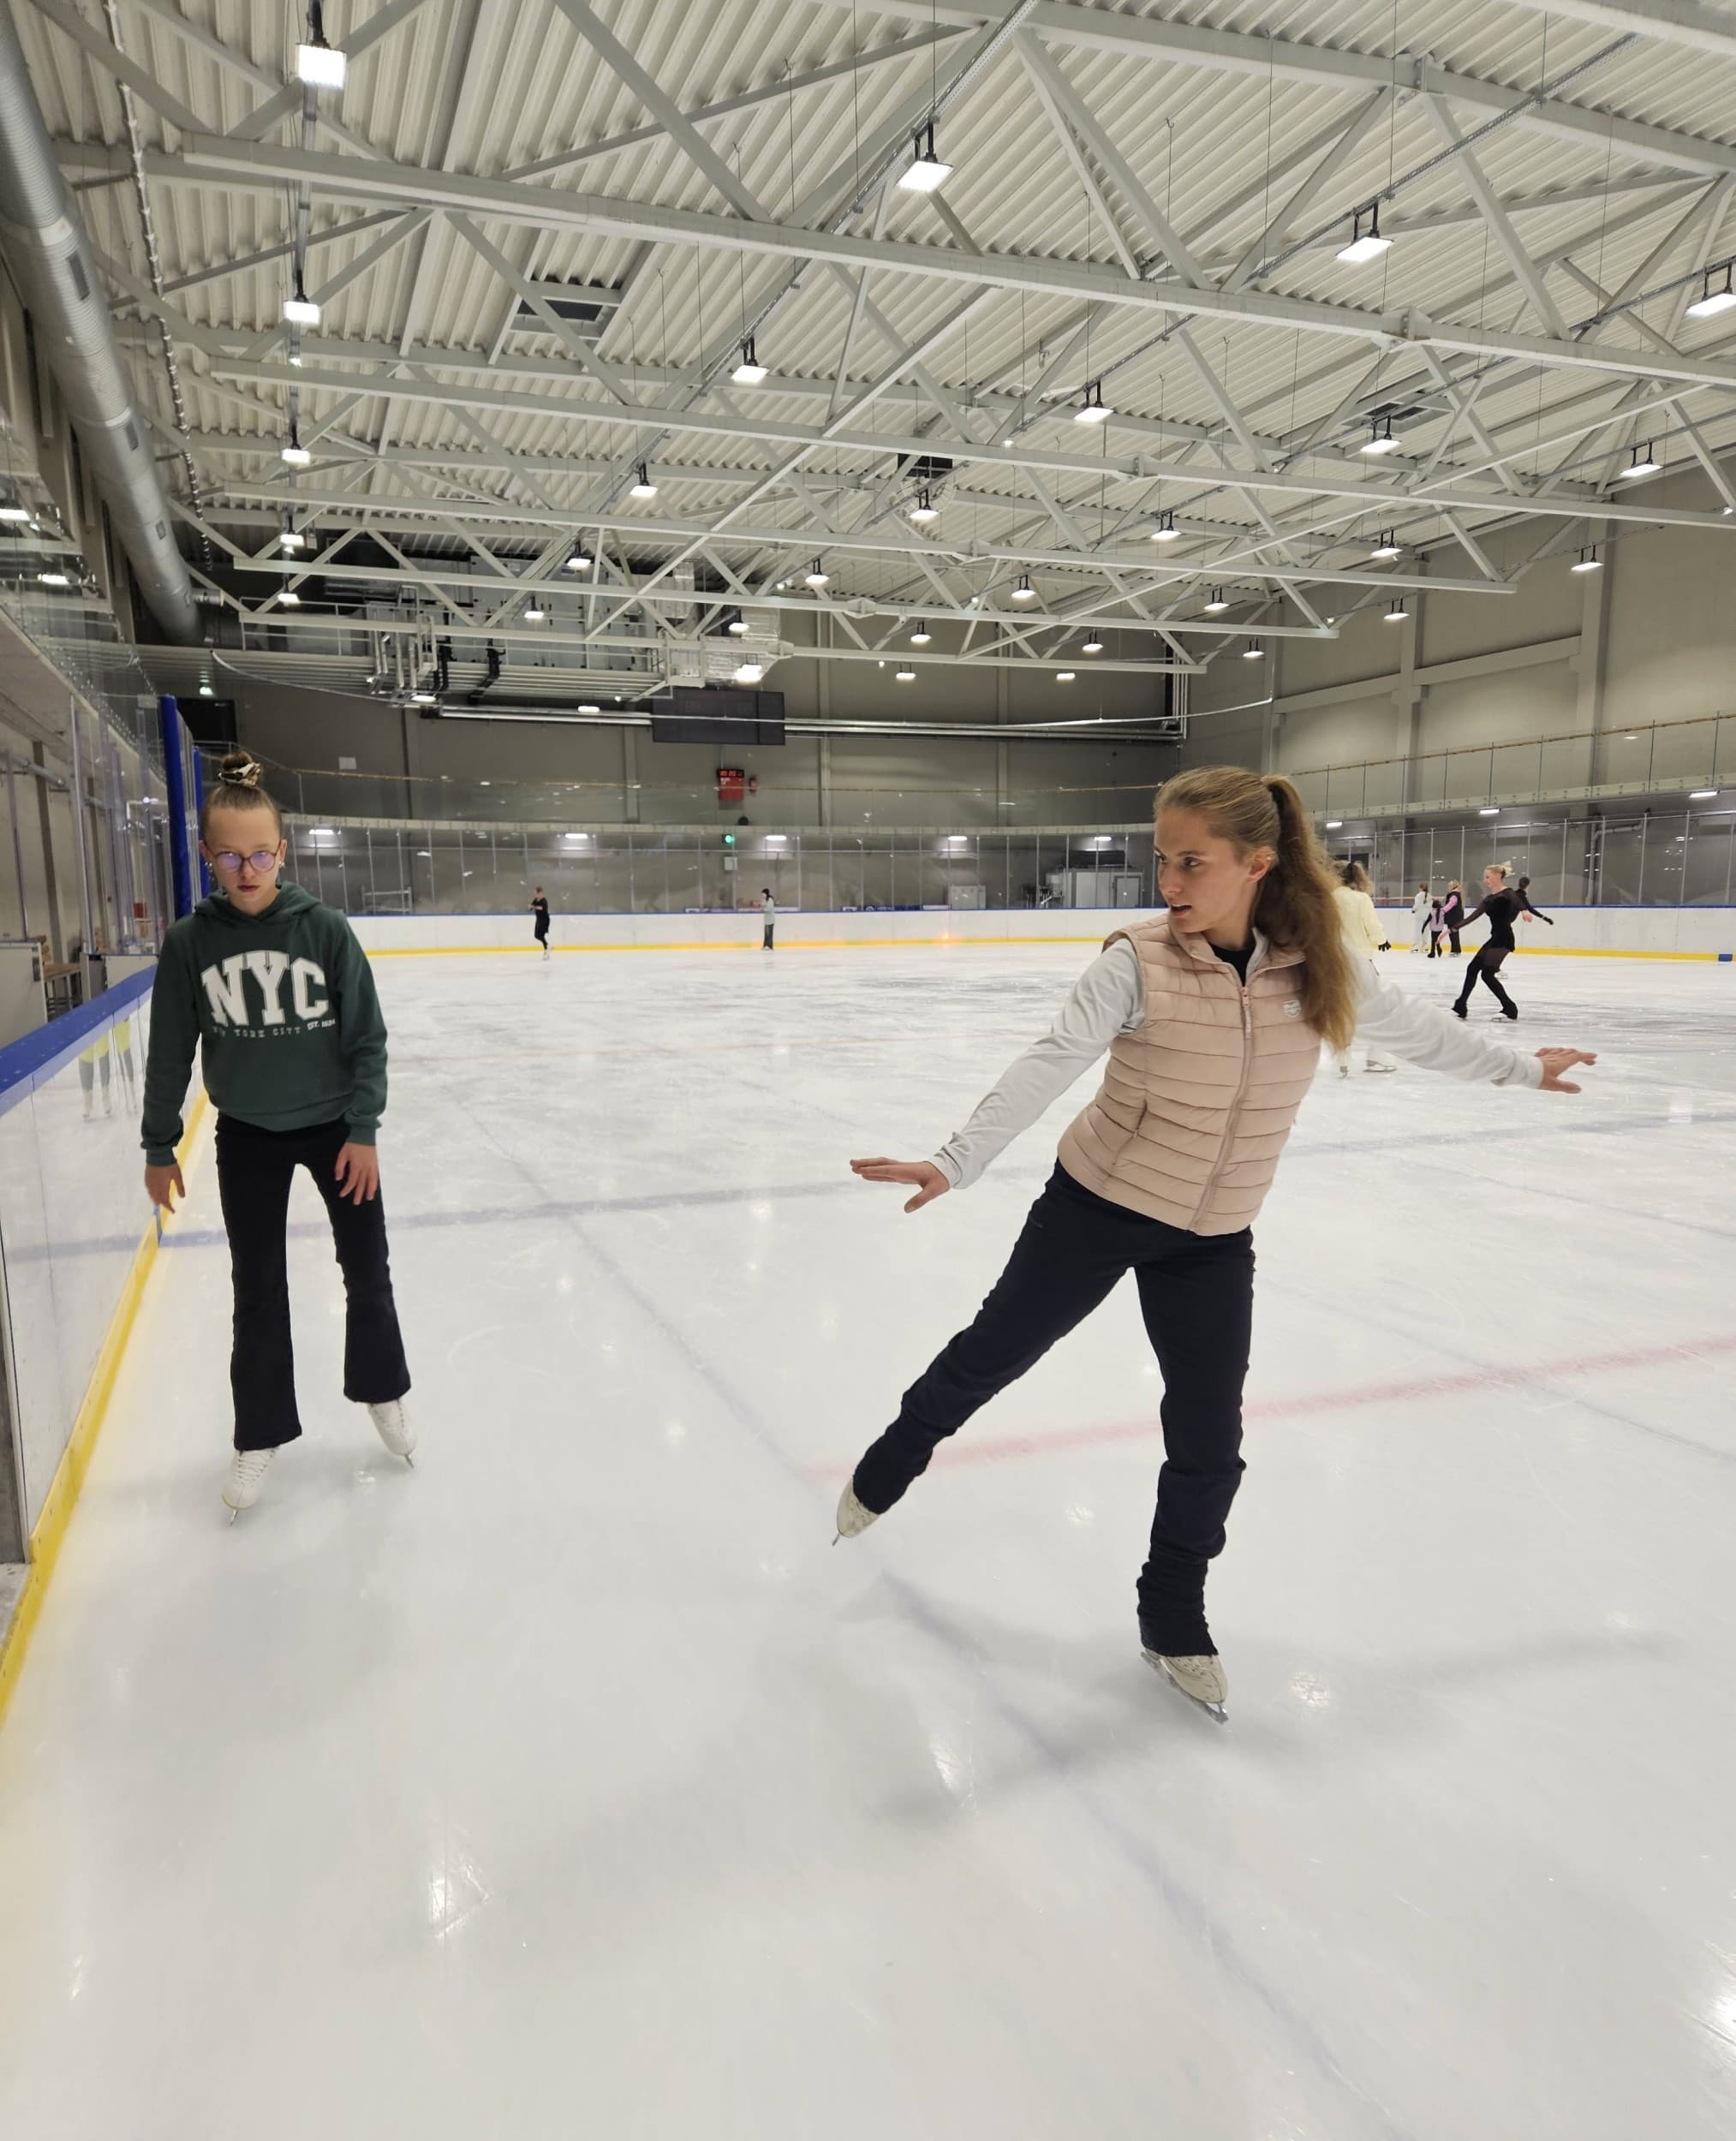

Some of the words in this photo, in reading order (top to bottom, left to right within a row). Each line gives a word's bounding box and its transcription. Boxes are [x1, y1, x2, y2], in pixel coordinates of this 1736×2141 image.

[200, 950, 330, 1027] NYC
[233, 1029, 265, 1038] YORK
[272, 1027, 301, 1036] CITY
